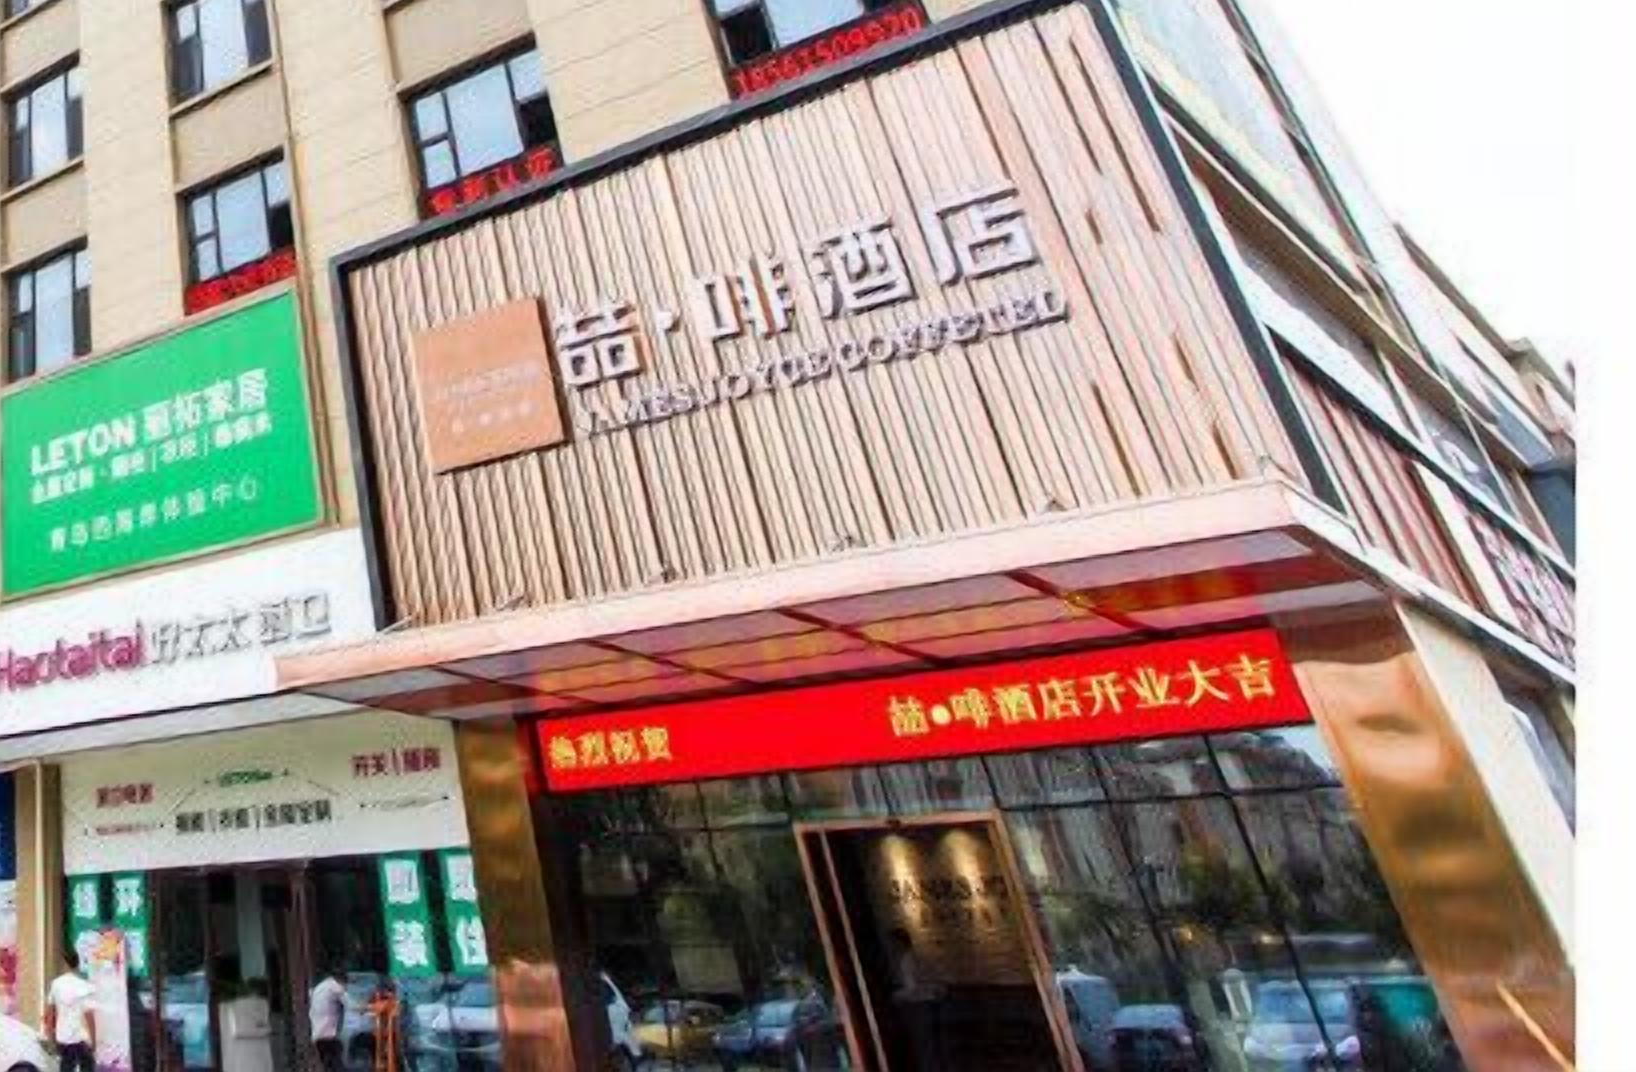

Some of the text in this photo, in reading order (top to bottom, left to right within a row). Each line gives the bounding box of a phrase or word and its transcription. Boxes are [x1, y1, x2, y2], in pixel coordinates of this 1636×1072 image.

[30, 414, 137, 477] LETON
[549, 725, 673, 770] 热烈祝贺
